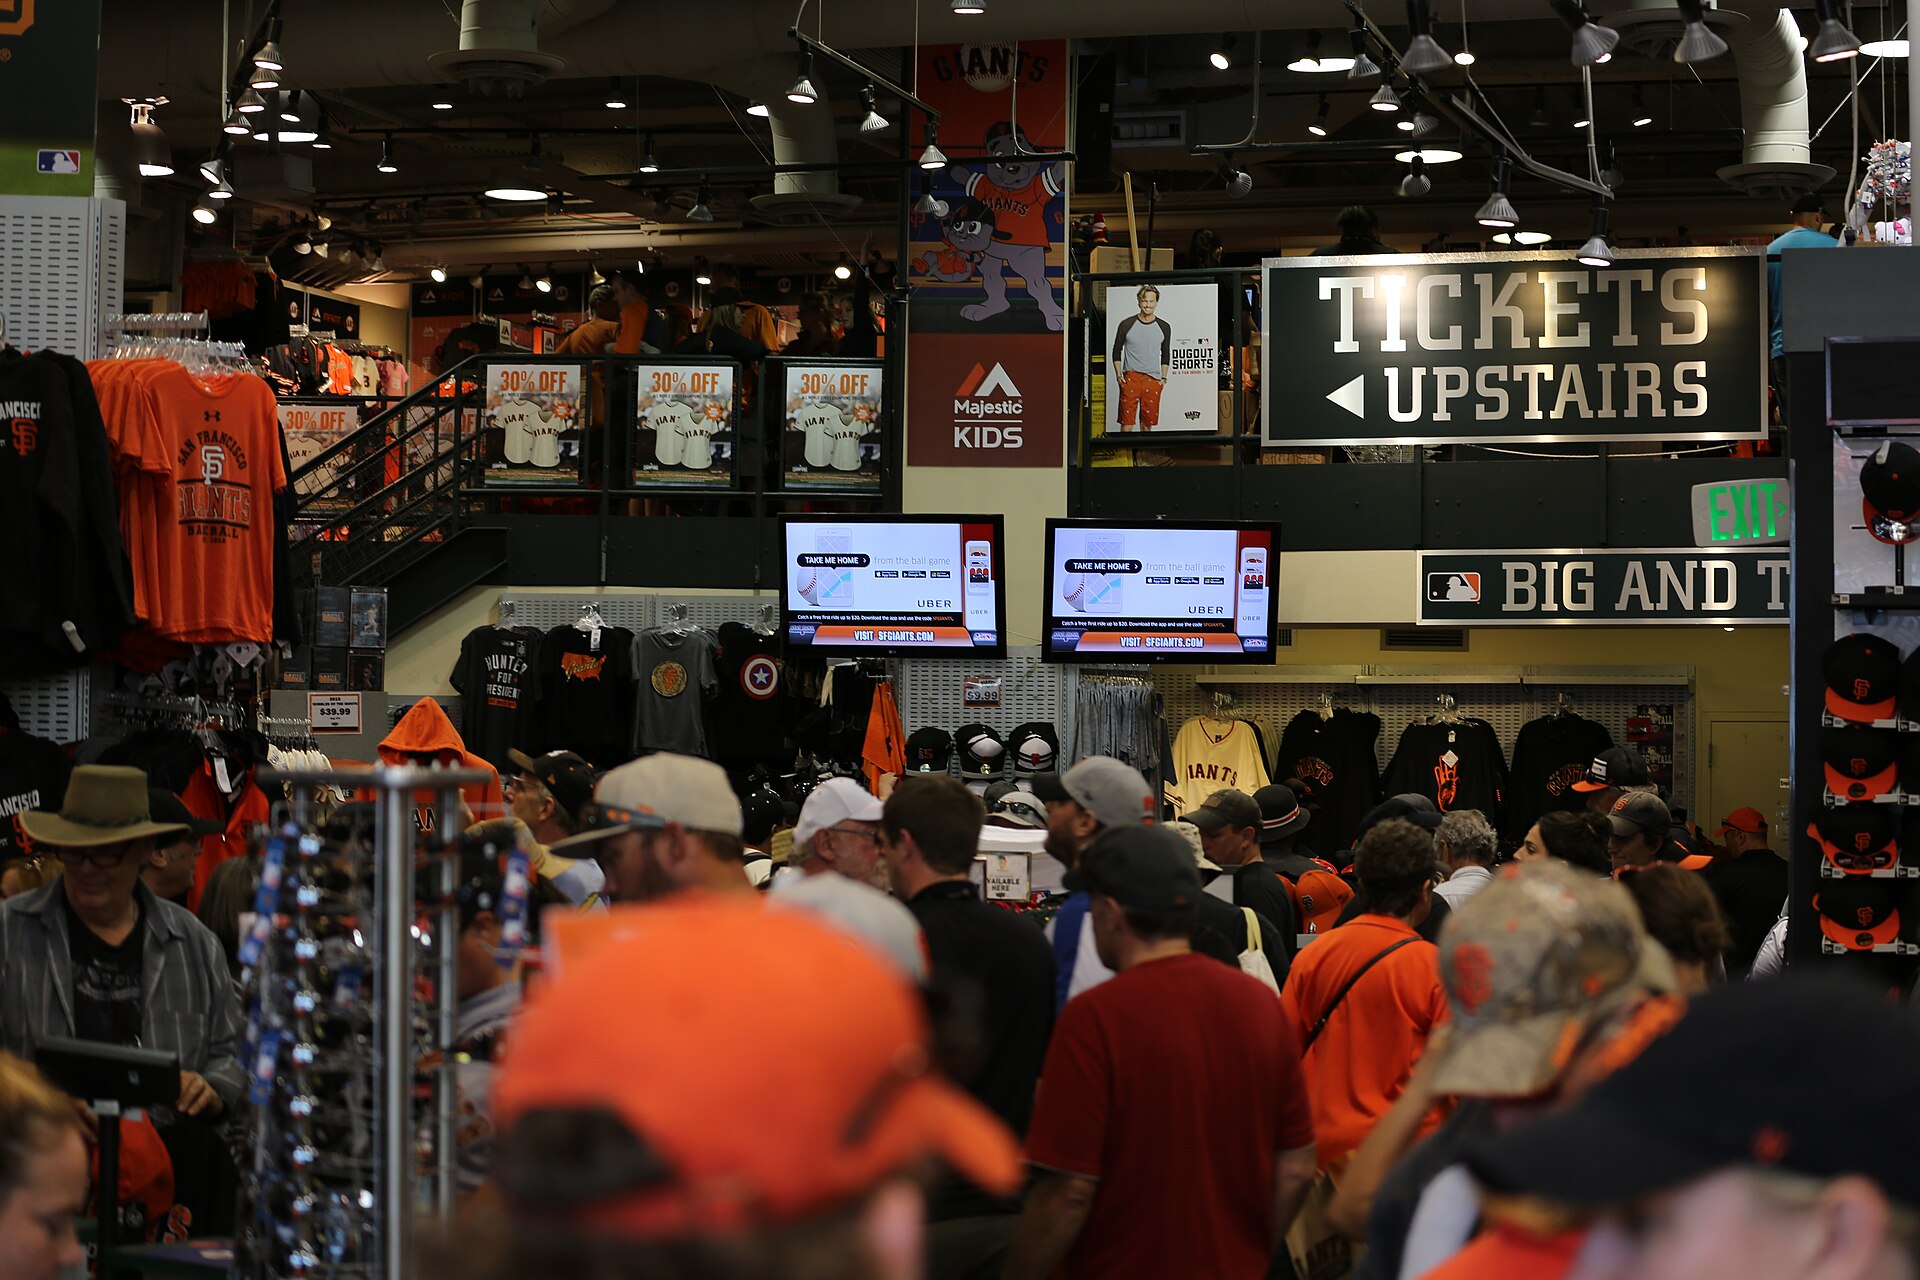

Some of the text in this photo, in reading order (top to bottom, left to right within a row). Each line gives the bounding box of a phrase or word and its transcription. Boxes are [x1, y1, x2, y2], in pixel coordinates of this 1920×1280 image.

[1319, 268, 1709, 353] TICKETS
[1172, 348, 1213, 359] DUGOUT
[1172, 359, 1213, 370] SHORTS
[500, 370, 568, 392] 30% OFF
[652, 372, 720, 393] 30% OFF
[800, 373, 868, 395] 30% OFF
[1384, 361, 1709, 423] UPSTAIRS
[954, 399, 1023, 419] Majestic
[286, 411, 346, 430] 30% OFF
[954, 427, 1023, 448] KIDS
[178, 430, 248, 470] SAN FRANCISCO
[1709, 483, 1778, 542] EXIT
[805, 556, 858, 564] TAKE ME HOME
[874, 557, 950, 566] from the ball game
[1073, 562, 1130, 571] TAKE ME HOME
[1146, 563, 1166, 571] from
[1185, 564, 1200, 572] ball
[1202, 564, 1225, 573] game
[1501, 561, 1594, 612] BIG
[1616, 560, 1738, 612] AND
[917, 600, 952, 608] UBER
[1188, 606, 1224, 614] UBER
[854, 630, 934, 642] VISIT SFGIANTS.COM
[1120, 636, 1204, 648] VISIT SFGIANTS.COM
[484, 654, 528, 675] HUNTER
[967, 691, 998, 700] $9.99
[320, 708, 351, 716] $39.99
[1188, 763, 1238, 786] IANTS
